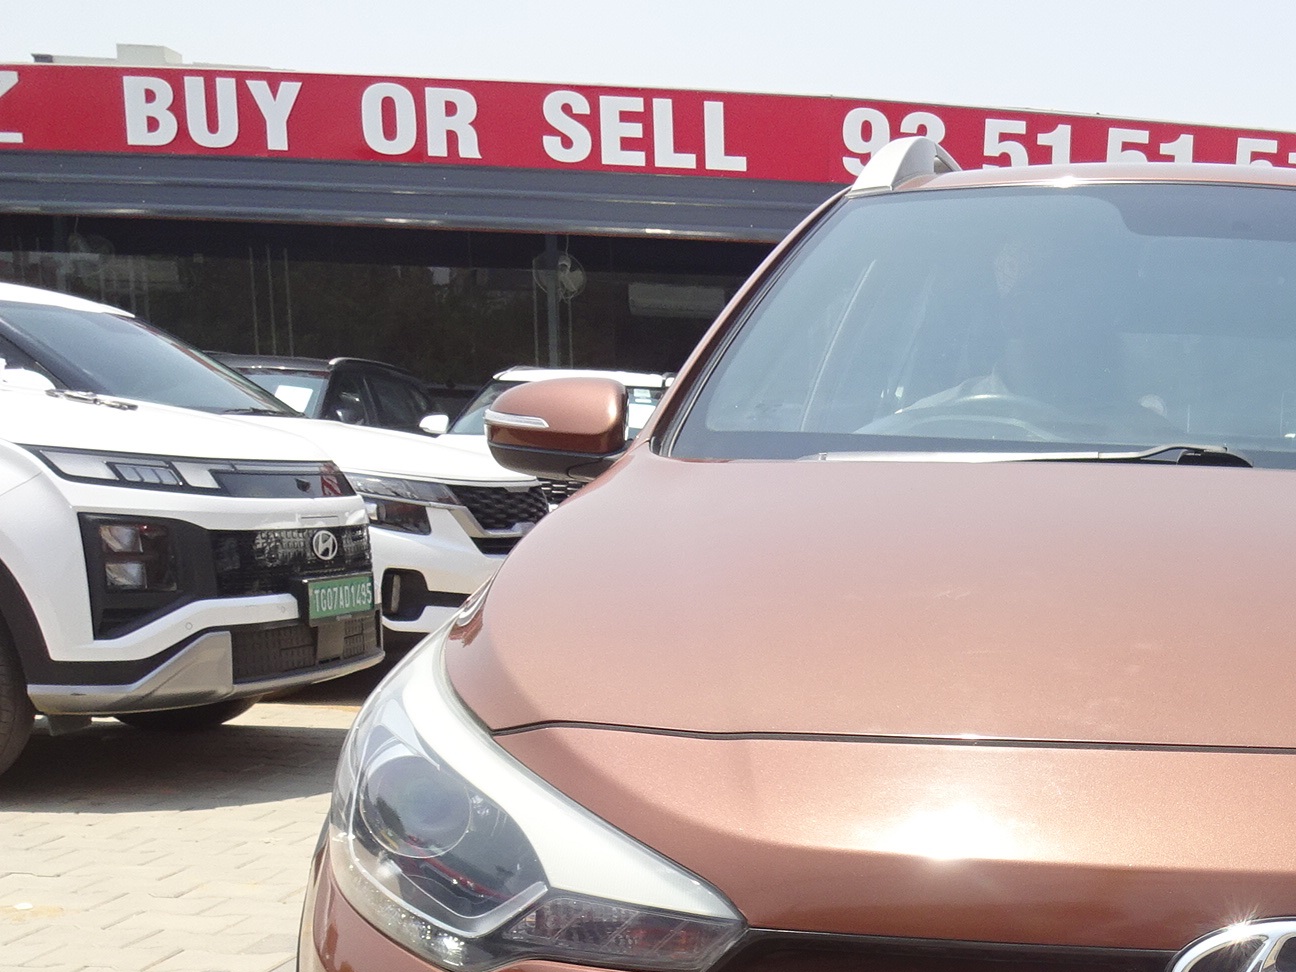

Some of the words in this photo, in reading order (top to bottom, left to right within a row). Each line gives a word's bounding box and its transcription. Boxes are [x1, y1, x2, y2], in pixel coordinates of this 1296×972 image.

[122, 75, 303, 151] BUY
[361, 82, 482, 159] OR
[542, 90, 747, 172] SELL
